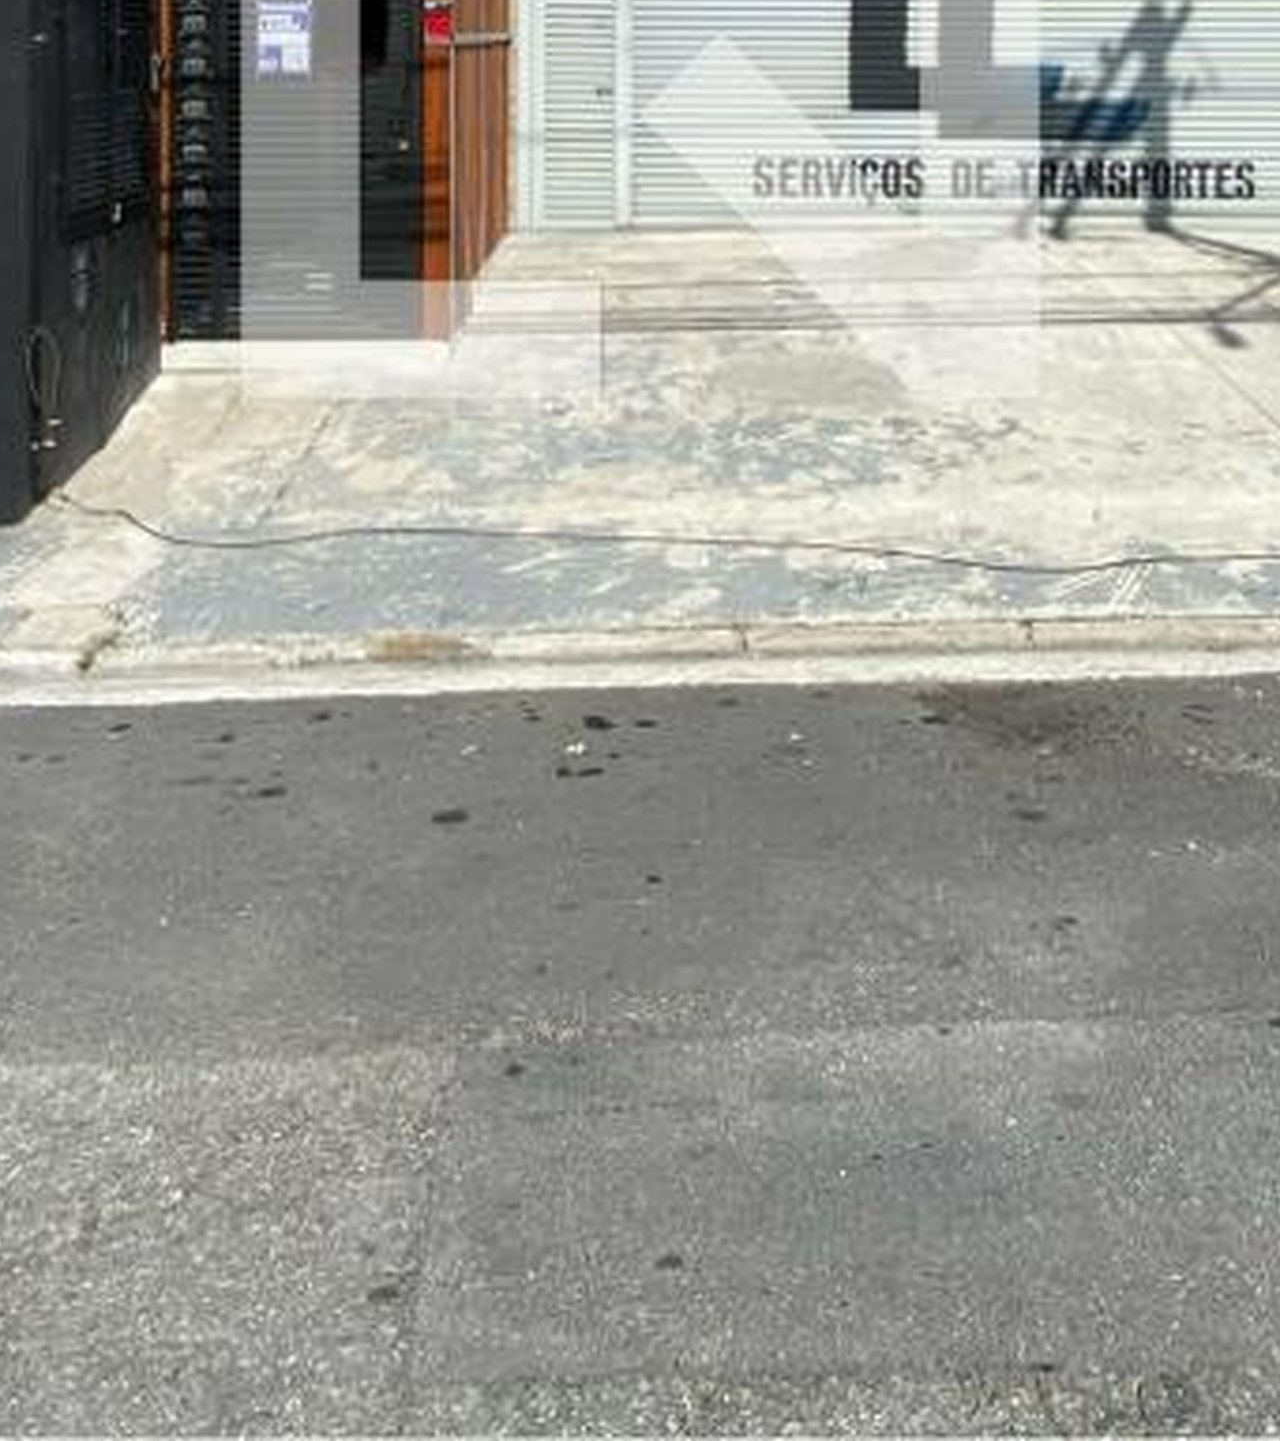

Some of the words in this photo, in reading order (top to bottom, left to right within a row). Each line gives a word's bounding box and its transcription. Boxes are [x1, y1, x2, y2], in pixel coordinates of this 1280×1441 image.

[752, 157, 926, 205] SERVIÇOS
[951, 158, 995, 198] DE
[1017, 158, 1256, 199] TRANSPORTES
